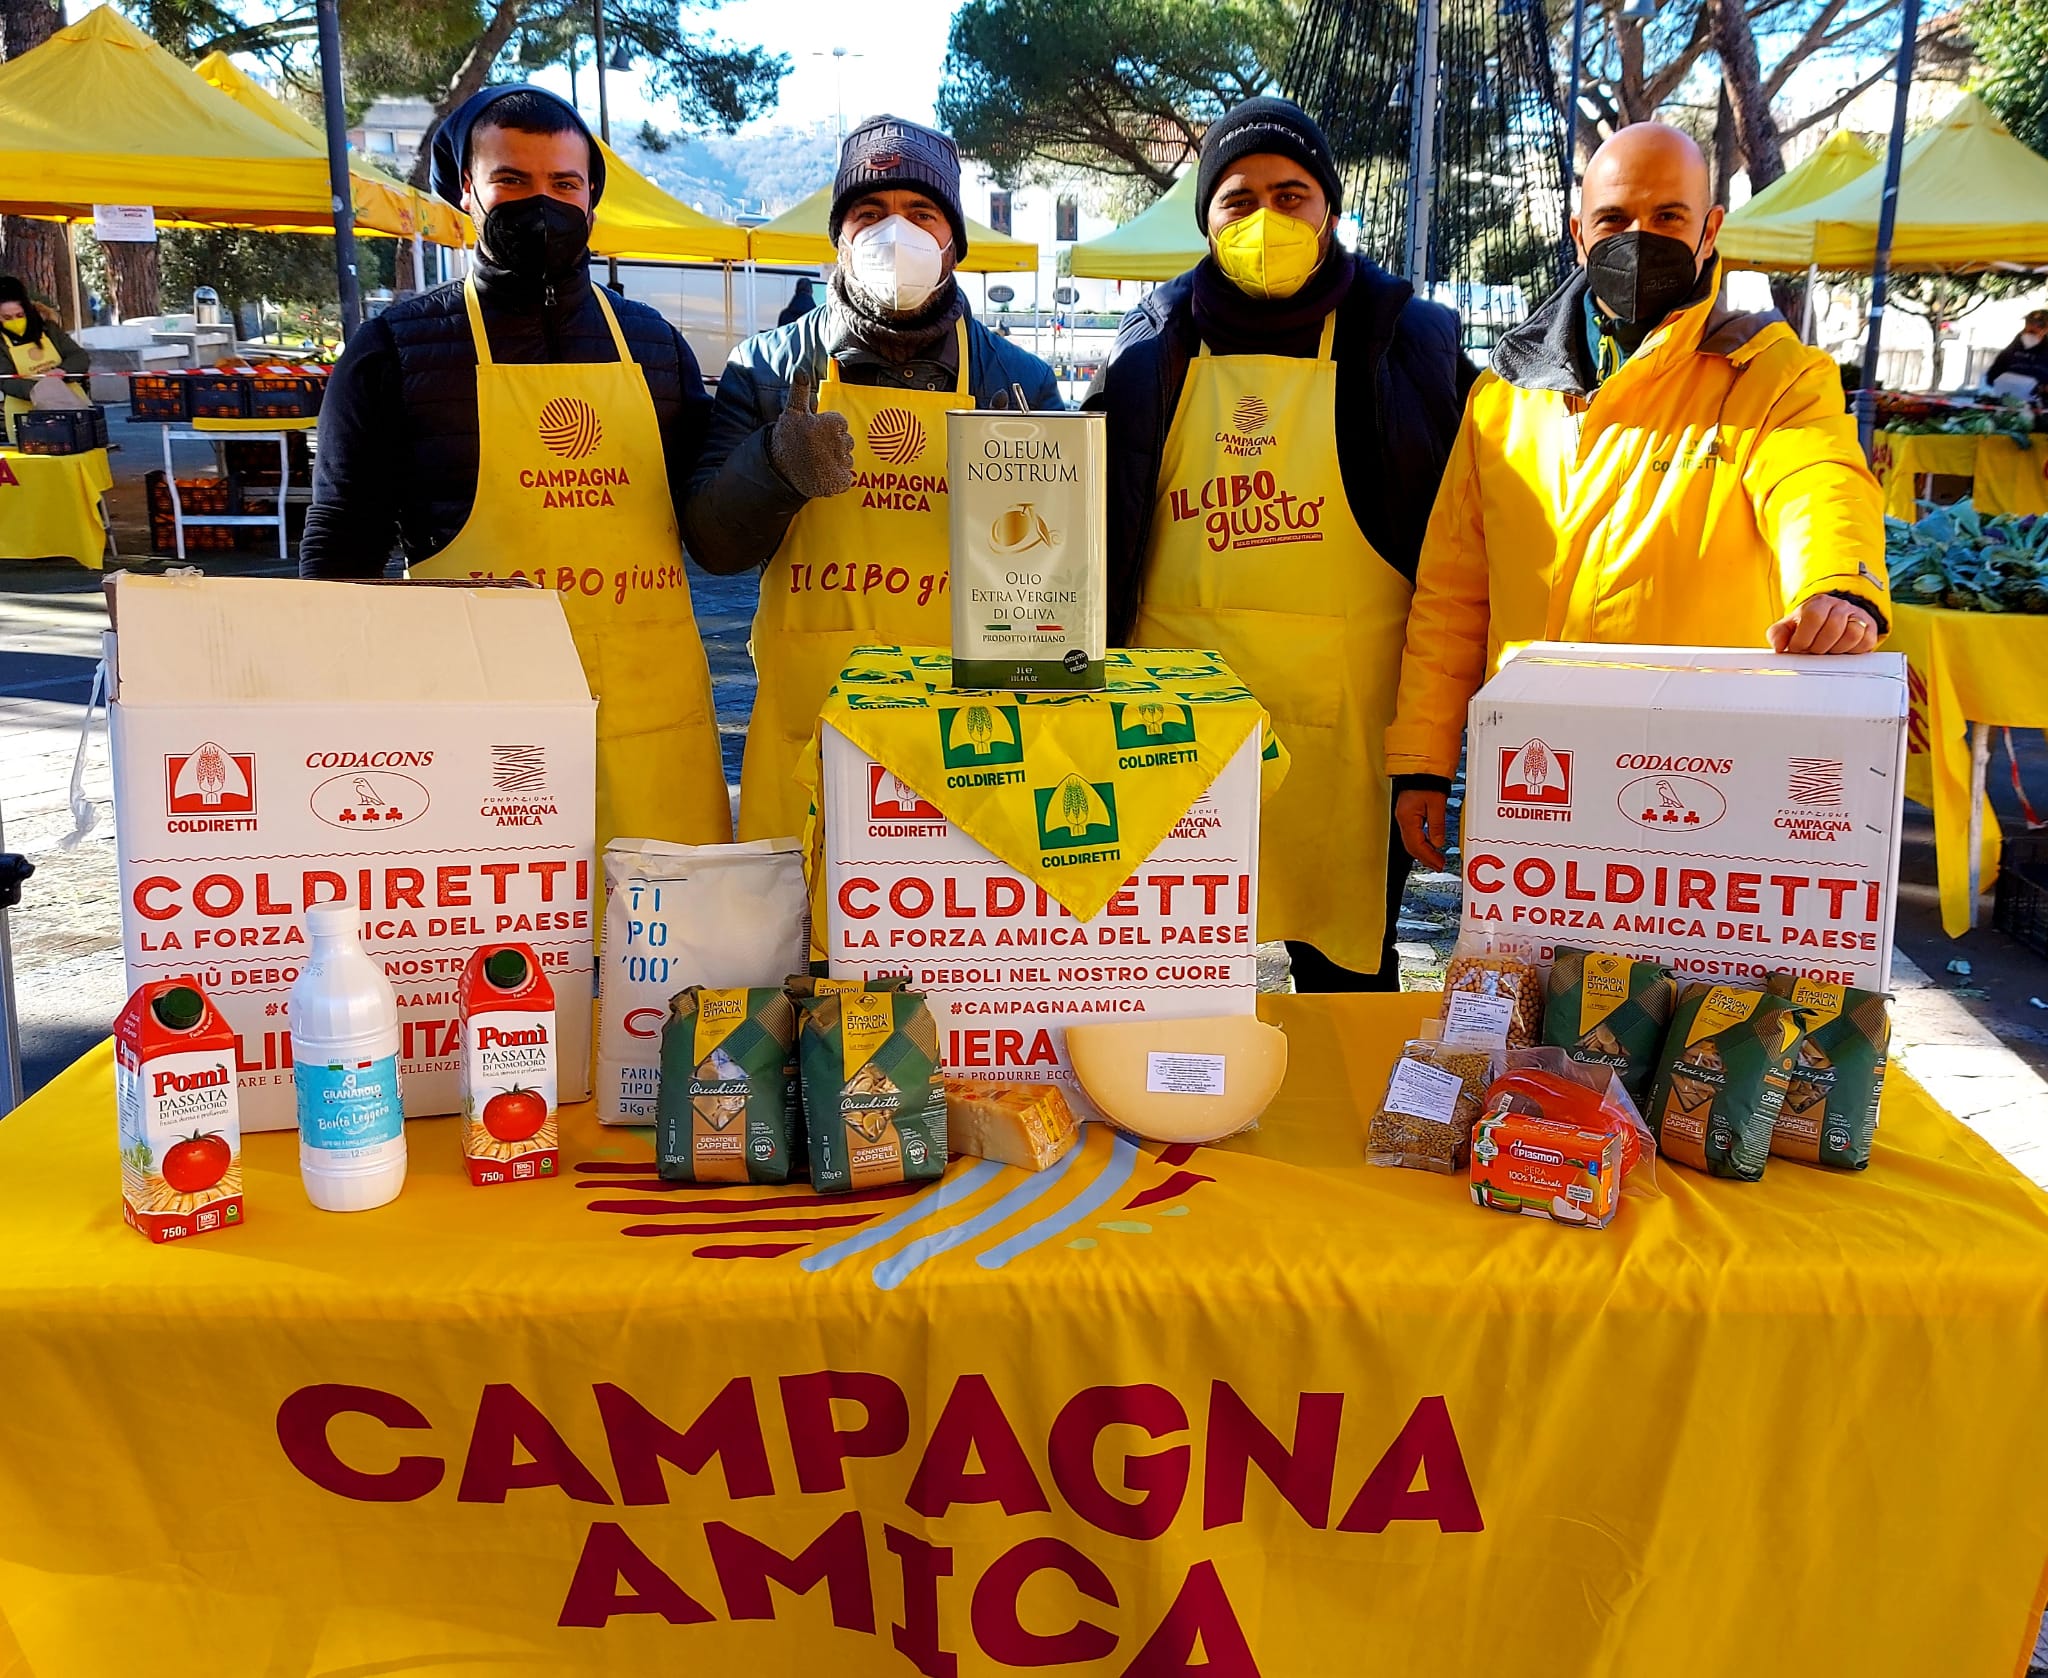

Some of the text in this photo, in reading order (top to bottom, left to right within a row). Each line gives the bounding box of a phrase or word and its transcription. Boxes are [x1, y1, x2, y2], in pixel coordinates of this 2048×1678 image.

[1215, 432, 1277, 446] CAMPAGNA
[984, 440, 1061, 459] OLEUM
[1224, 444, 1262, 456] AMICA
[519, 467, 630, 488] CAMPAGNA
[968, 462, 1078, 482] NOSTRUM
[850, 470, 948, 494] CAMPAGNA
[543, 489, 616, 509] AMICA
[861, 491, 931, 512] AMICA
[1170, 470, 1276, 521] IL CIBO
[1206, 490, 1325, 552] giusto
[614, 564, 683, 605] giusto
[790, 564, 812, 593] Il
[820, 562, 909, 595] CIBO
[982, 634, 1065, 643] PRODOTTO ITALIANO
[306, 751, 434, 768] CODACONS
[1119, 750, 1198, 770] COLDIRETTI
[1615, 752, 1734, 775] CODACONS
[947, 770, 1026, 788] COLDIRETTI
[480, 804, 558, 817] CAMPAGNA
[1497, 806, 1572, 822] COLDIRETTI
[1777, 809, 1850, 817] FONDAZIONE
[167, 819, 258, 834] COLDIRETTI
[496, 815, 543, 827] AMICA
[1773, 817, 1852, 832] CAMPAGNA
[868, 825, 947, 837] COLDIRETTI
[1788, 828, 1836, 841] AMICA
[1041, 849, 1121, 869] COLDIRETTI
[133, 860, 588, 921] COLDIRETTI
[1467, 854, 1880, 921] COLDIRETTI
[838, 875, 1249, 920] COLDIETTI
[141, 931, 182, 951] LA
[194, 925, 305, 949] FORZA
[428, 916, 485, 937] DEL
[496, 910, 588, 933] PAESE
[1471, 902, 1876, 951] LA FORZA AMICA DEL PAESE
[844, 925, 1249, 948] LA FORZA AMICA DEL PAESE
[231, 958, 463, 986] DEBO NOSTR
[921, 968, 1001, 984] DEBOLI
[1009, 967, 1050, 983] NEL
[1058, 966, 1148, 982] NOSTRO
[1155, 965, 1231, 980] CUORE
[1674, 957, 1767, 979] NOSTRO
[1587, 976, 1625, 985] STAGIONI
[1588, 982, 1624, 993] D'ITALIA
[1712, 992, 1750, 1012] STAGIONI
[1797, 989, 1839, 1000] STAGIONI
[704, 1000, 742, 1012] STAGIONI
[950, 999, 1145, 1015] #CAMPAGNAAMICA
[1709, 998, 1745, 1016] D'ITALIA
[1796, 997, 1837, 1009] D'ITALIA
[704, 1007, 742, 1018] D'ITALIA
[847, 1014, 888, 1022] STAGIONI
[847, 1020, 888, 1030] D'ITALIA
[477, 1023, 549, 1050] Pomì
[483, 1048, 546, 1064] PASSATA
[495, 1059, 546, 1070] POMODORO
[153, 1063, 230, 1097] Pomì
[972, 1070, 1040, 1081] PRODURRE
[323, 1085, 381, 1100] GRANAROLO
[620, 1082, 654, 1095] TIPO
[689, 1082, 750, 1096] Orecchiette
[160, 1089, 228, 1112] PASSATA
[841, 1096, 901, 1111] Orecchiette
[172, 1101, 227, 1117] POMODORO
[352, 1106, 389, 1125] Leggera
[620, 1102, 645, 1116] 3 Kg
[1665, 1118, 1703, 1134] CAPPELLI
[1775, 1120, 1817, 1134] CAPPELLI
[1780, 1115, 1815, 1126] SENATORE
[1828, 1134, 1847, 1144] 100%
[852, 1151, 898, 1163] CAPPELLI
[856, 1145, 893, 1157] SENATORE
[1518, 1148, 1559, 1164] Plasmon
[480, 1171, 503, 1183] 750g
[821, 1171, 834, 1180] 500g
[1524, 1165, 1546, 1176] PERA
[1528, 1174, 1563, 1188] Naturale
[162, 1226, 187, 1239] 750g
[276, 1370, 1485, 1541] CAMPAGNA
[557, 1509, 1262, 1678] AMICA
